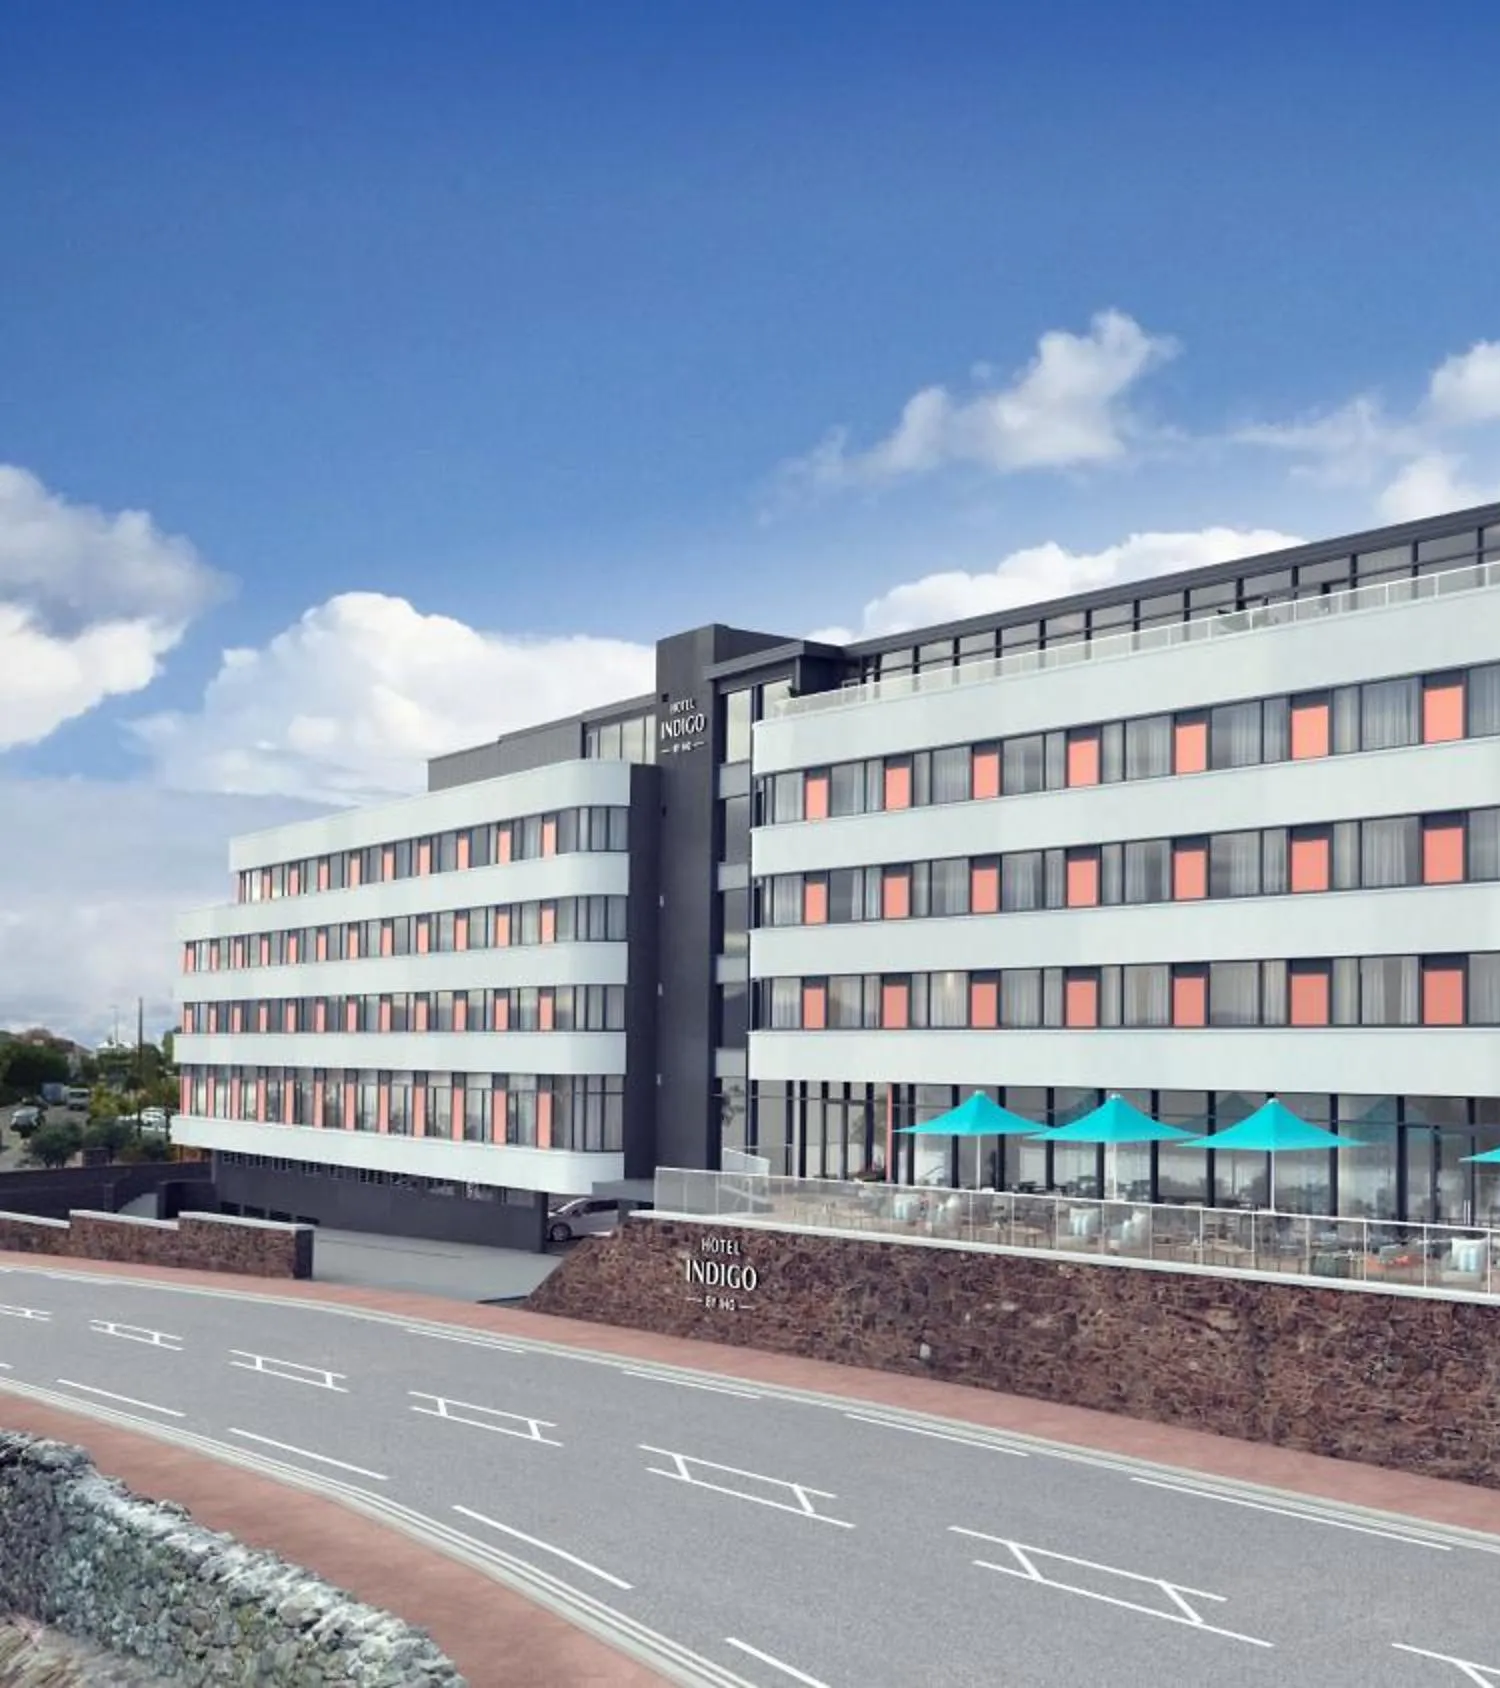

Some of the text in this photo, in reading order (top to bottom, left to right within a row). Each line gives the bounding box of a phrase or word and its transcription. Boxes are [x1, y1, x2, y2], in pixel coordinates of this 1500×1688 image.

[661, 713, 705, 739] INDIGO
[702, 1237, 740, 1255] HOTEL
[687, 1259, 757, 1291] INDIGO
